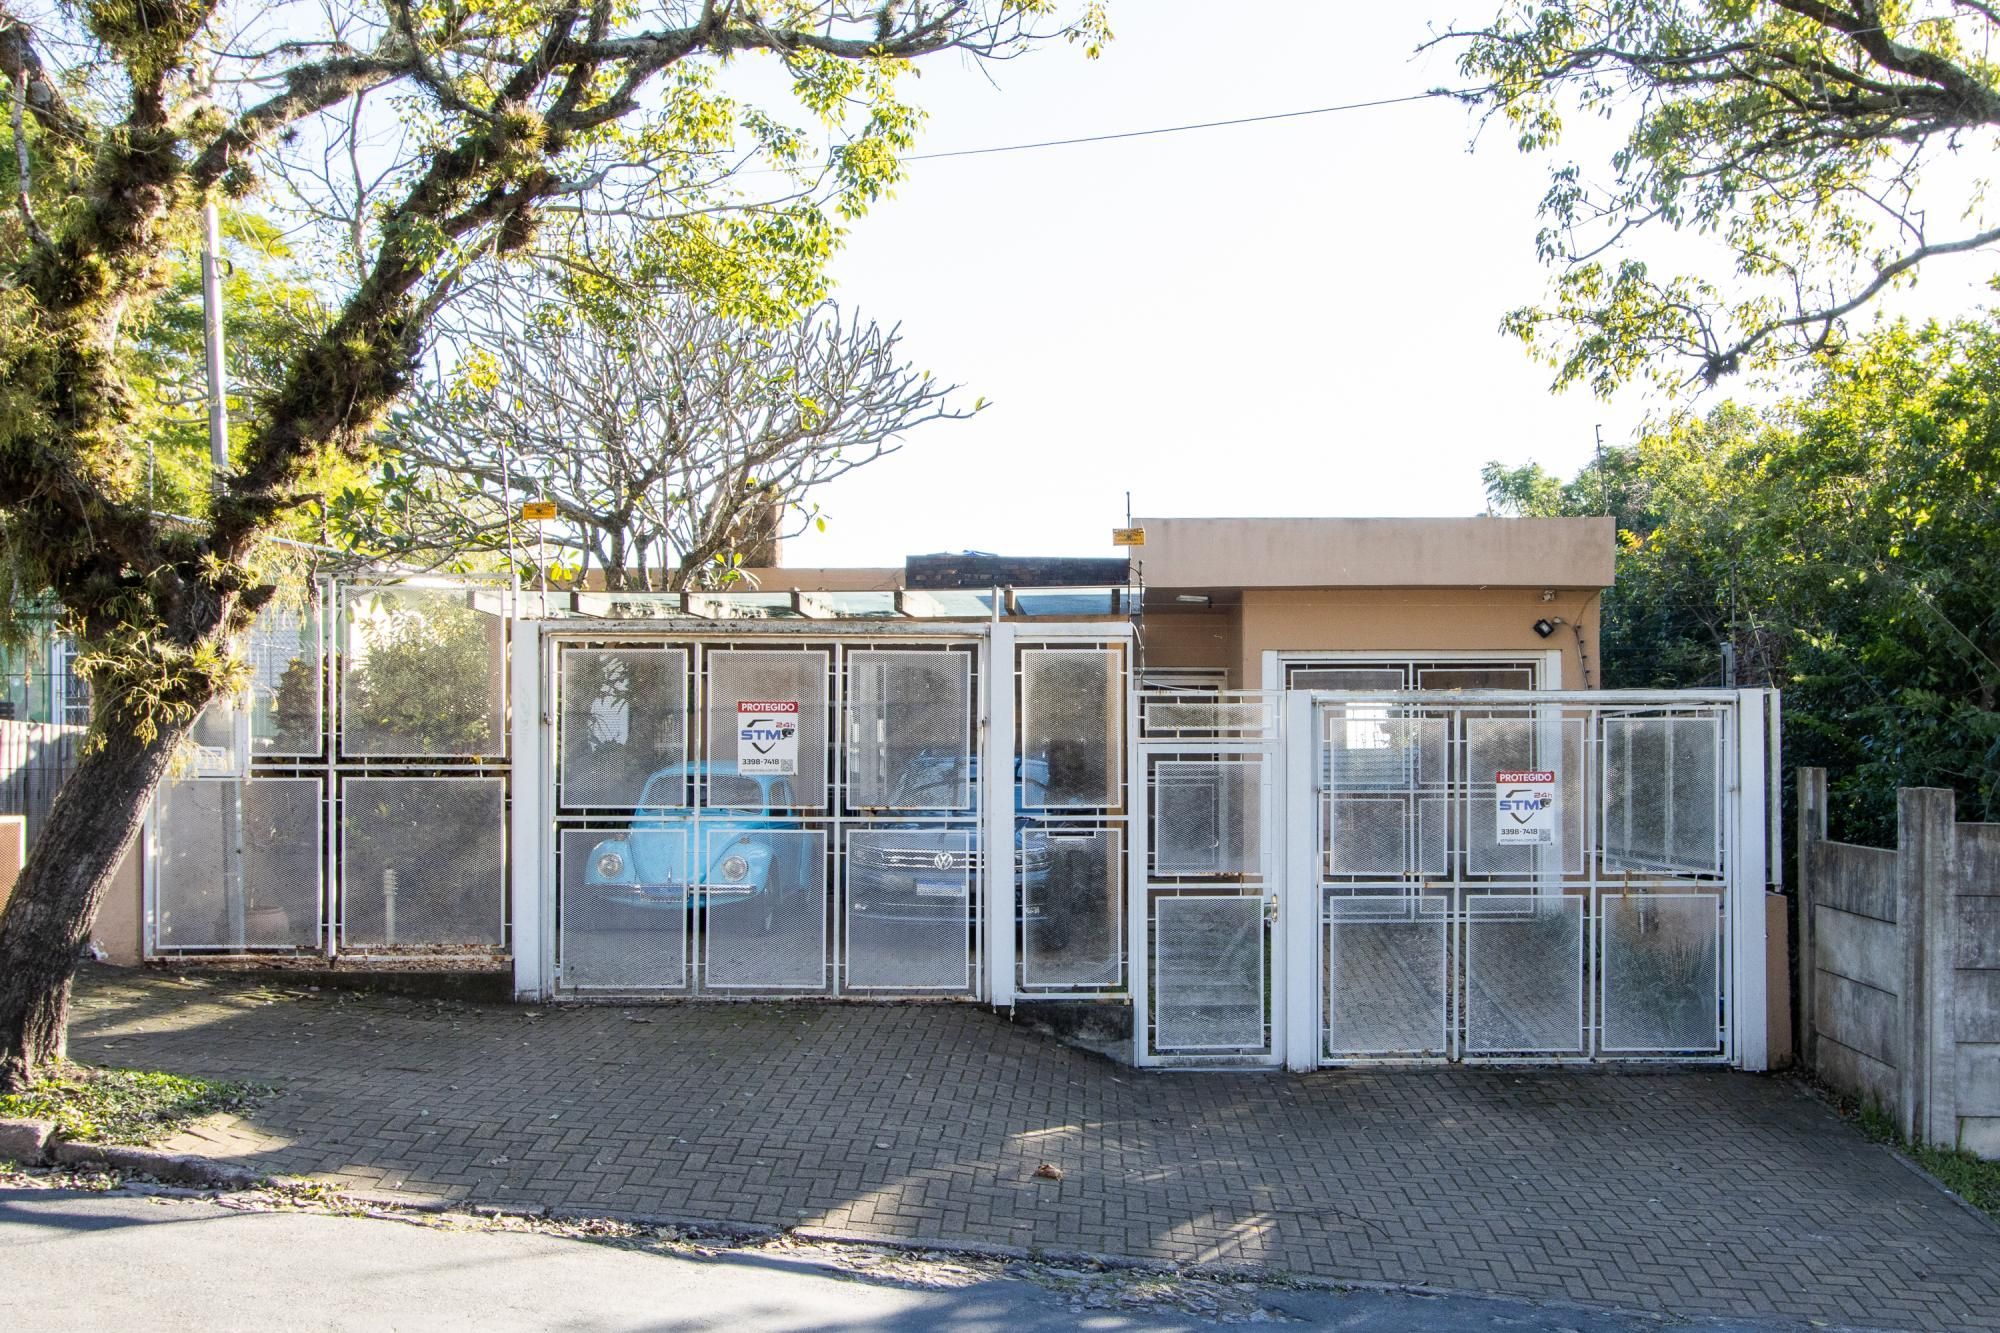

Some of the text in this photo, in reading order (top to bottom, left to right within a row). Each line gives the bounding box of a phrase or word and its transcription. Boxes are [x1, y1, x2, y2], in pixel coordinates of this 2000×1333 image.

[741, 703, 795, 712] PROTEGIDO
[741, 729, 781, 740] STM
[1499, 773, 1552, 782] PROTEGIDO
[1499, 799, 1539, 811] STM
